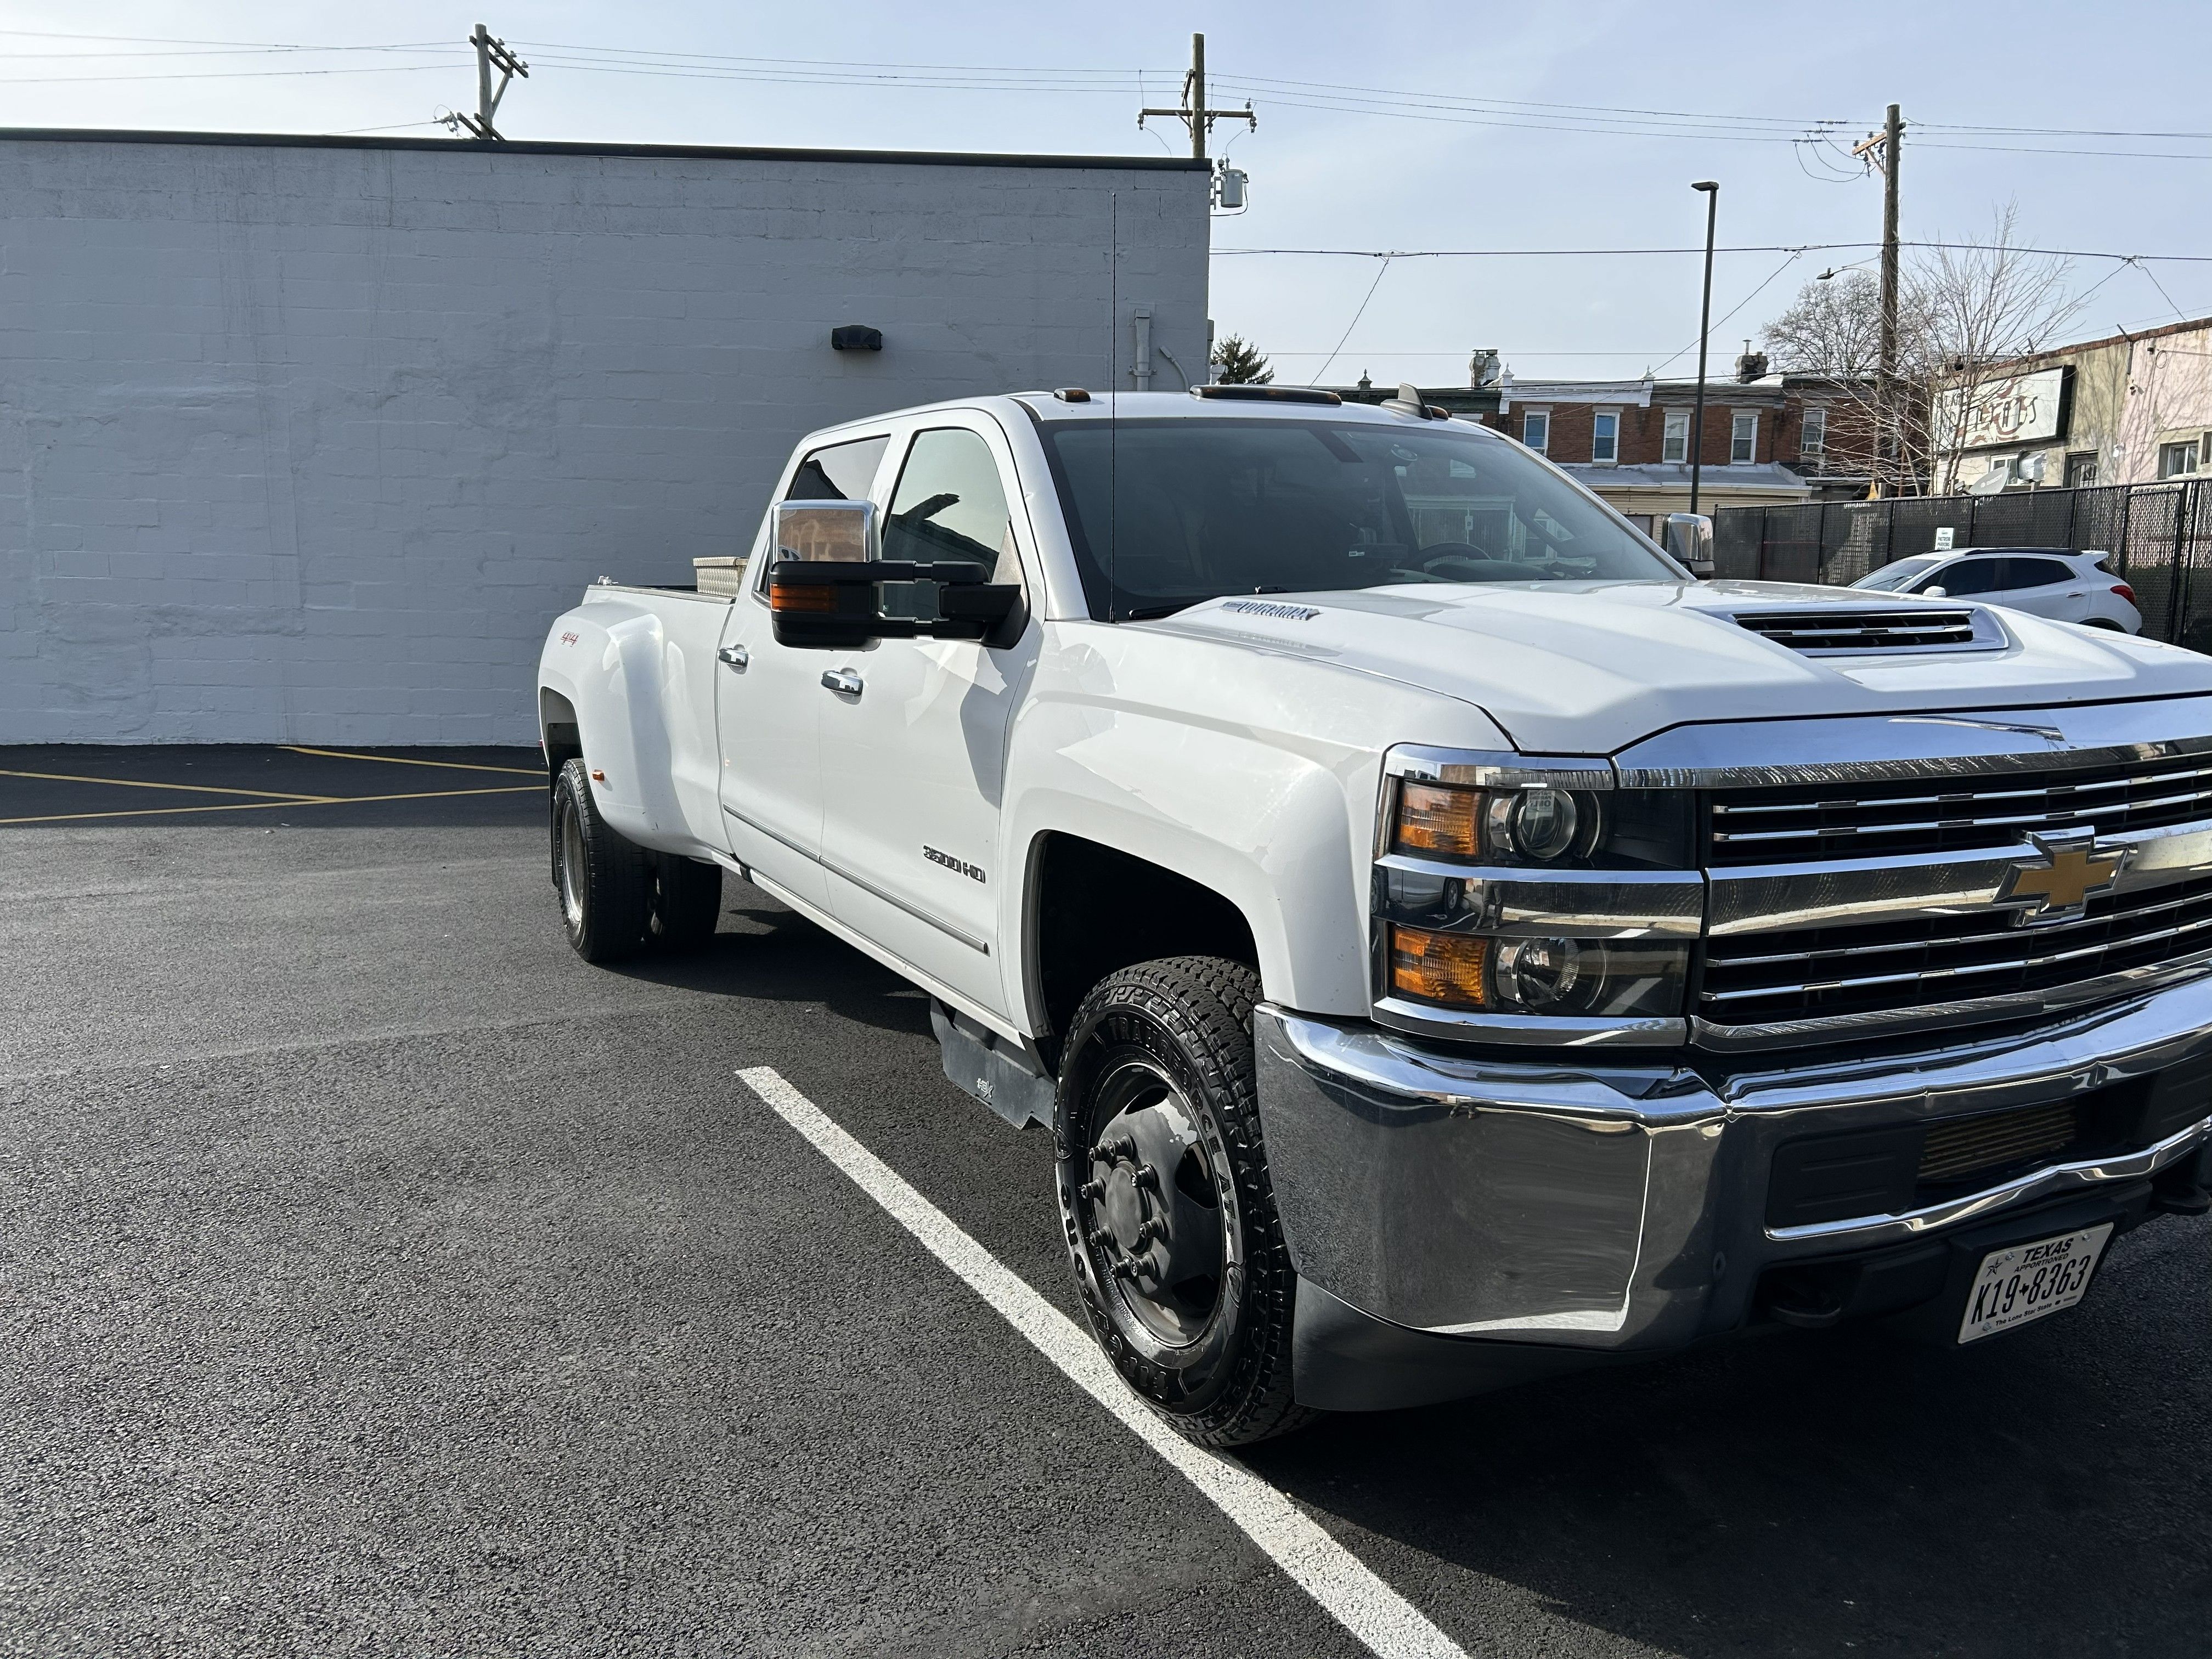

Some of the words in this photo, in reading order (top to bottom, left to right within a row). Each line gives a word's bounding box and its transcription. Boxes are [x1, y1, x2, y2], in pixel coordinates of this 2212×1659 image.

[2023, 1238, 2074, 1263] TEXAS
[2013, 1252, 2069, 1273] APPORTIONED
[2008, 1312, 2023, 1322] Lone
[2024, 1307, 2035, 1317] Star
[2037, 1302, 2052, 1312] State
